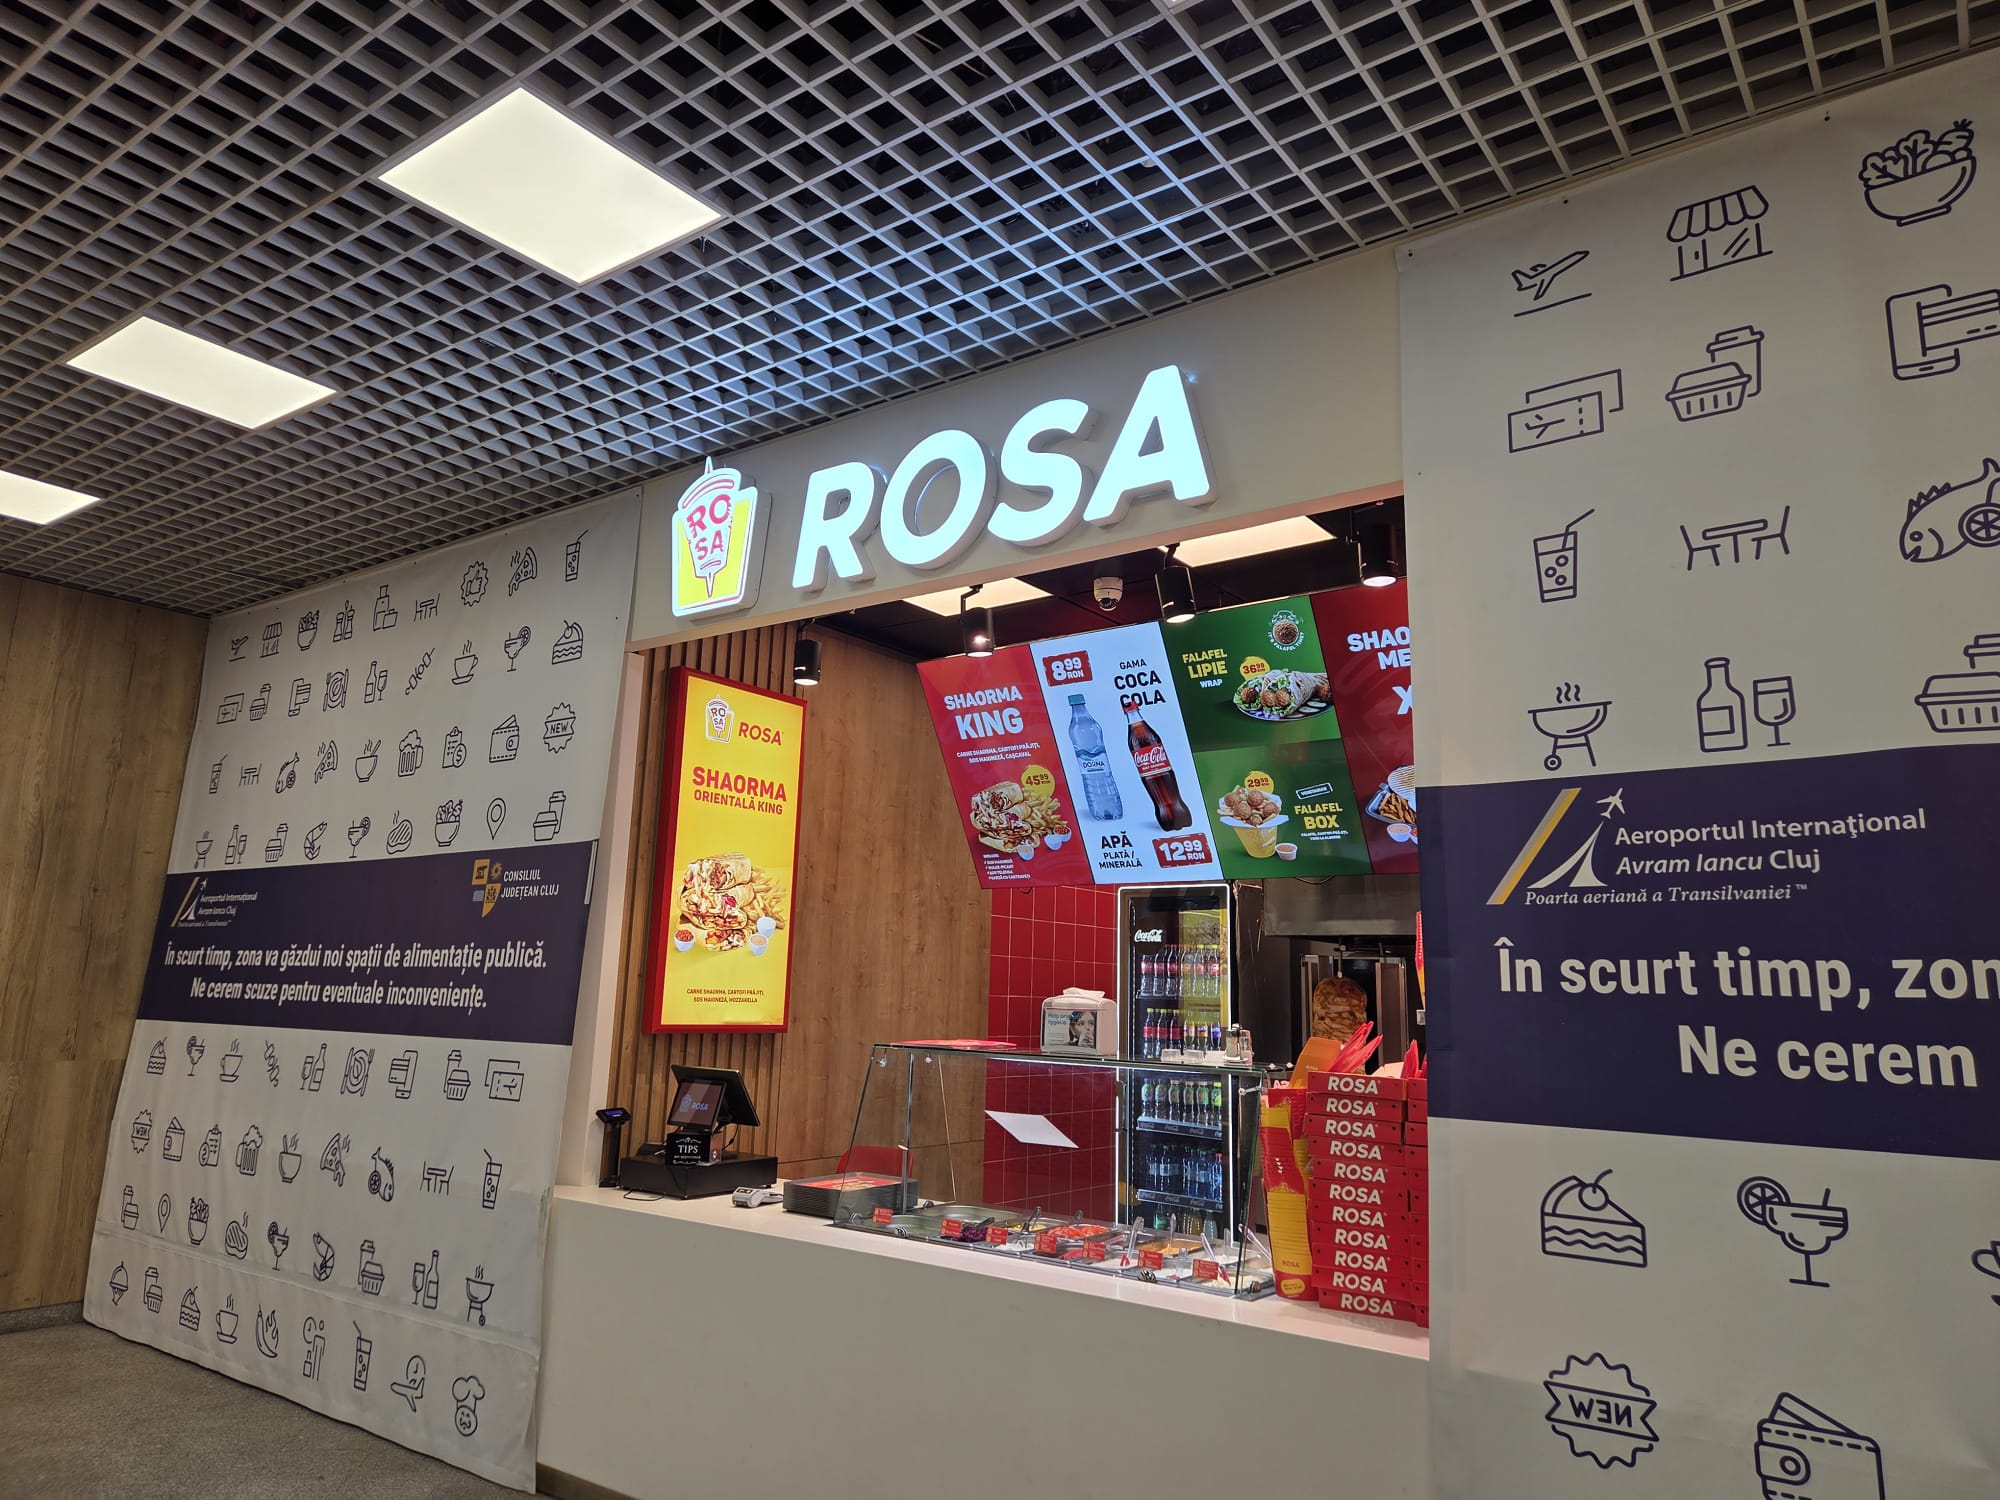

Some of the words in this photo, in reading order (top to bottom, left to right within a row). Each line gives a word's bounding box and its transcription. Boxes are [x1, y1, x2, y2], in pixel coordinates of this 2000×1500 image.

[792, 365, 1213, 590] ROSA
[686, 494, 732, 538] RO
[695, 530, 724, 560] SA
[1119, 659, 1147, 670] GAMA
[1182, 648, 1228, 663] FALAFEL
[1066, 670, 1085, 679] RON
[1188, 660, 1228, 679] LIPIE
[1114, 670, 1162, 690] COCA
[1200, 678, 1223, 688] WRAP
[944, 685, 1023, 711] SHAORMA
[1120, 689, 1166, 708] COLA
[710, 707, 726, 718] RO
[713, 718, 724, 726] SA
[550, 721, 569, 734] NEW
[955, 707, 1024, 740] KING
[738, 722, 783, 746] ROSA
[1083, 760, 1105, 769] DORNA
[1135, 746, 1167, 767] Coca-Cola
[692, 766, 787, 802] SHAORMA
[694, 789, 755, 811] ORIENTALĂ
[758, 801, 783, 815] KING
[1294, 802, 1343, 815] FALAFEL
[1303, 815, 1340, 830] BOX
[1101, 831, 1133, 849] APĂ
[1614, 819, 1745, 849] Aeroportul
[1099, 858, 1143, 869] MINERALĂ
[1187, 852, 1206, 861] RON
[1616, 856, 1691, 876] Avram
[1696, 852, 1763, 874] Iancu
[1769, 848, 1821, 874] Cluj
[503, 869, 541, 882] CONSILIUL
[500, 885, 539, 900] JUDEȚEAN
[540, 884, 559, 897] CLUJ
[1525, 889, 1580, 906] Poarta
[1582, 886, 1648, 904] aeriană
[1652, 891, 1664, 903] a
[1667, 883, 1792, 903] Transilvaniei
[164, 941, 175, 966] În
[176, 945, 205, 967] scurt
[205, 944, 233, 971] timp,
[235, 948, 262, 967] zona
[265, 948, 277, 967] va
[279, 943, 322, 972] găzdui
[323, 943, 345, 967] noi
[345, 943, 383, 975] spații
[383, 943, 401, 968] de
[402, 942, 482, 975] alimentație
[484, 940, 547, 974] publică.
[1493, 936, 1543, 993] În
[1560, 951, 1699, 997] scurt
[1713, 945, 1871, 1012] timp,
[1891, 958, 2000, 1000] zon
[190, 976, 206, 998] Ne
[206, 981, 243, 999] cerem
[244, 982, 277, 1000] scuze
[278, 980, 321, 1006] pentru
[322, 978, 384, 1005] eventuale
[386, 980, 487, 1016] inconveniențe.
[1678, 1024, 1758, 1079] Ne
[1776, 1038, 1978, 1088] cerem
[1327, 1076, 1379, 1095] ROSA
[1326, 1098, 1376, 1116] ROSA
[1325, 1119, 1376, 1138] ROSA
[678, 1145, 699, 1154] TIPS
[1330, 1140, 1382, 1161] ROSA
[1334, 1163, 1386, 1183] ROSA
[1329, 1184, 1382, 1205] ROSA
[1332, 1206, 1385, 1227] ROSA
[1335, 1228, 1388, 1250] ROSA
[1335, 1250, 1388, 1272] ROSA
[1333, 1271, 1385, 1294] ROSA
[1341, 1293, 1394, 1316] ROSA
